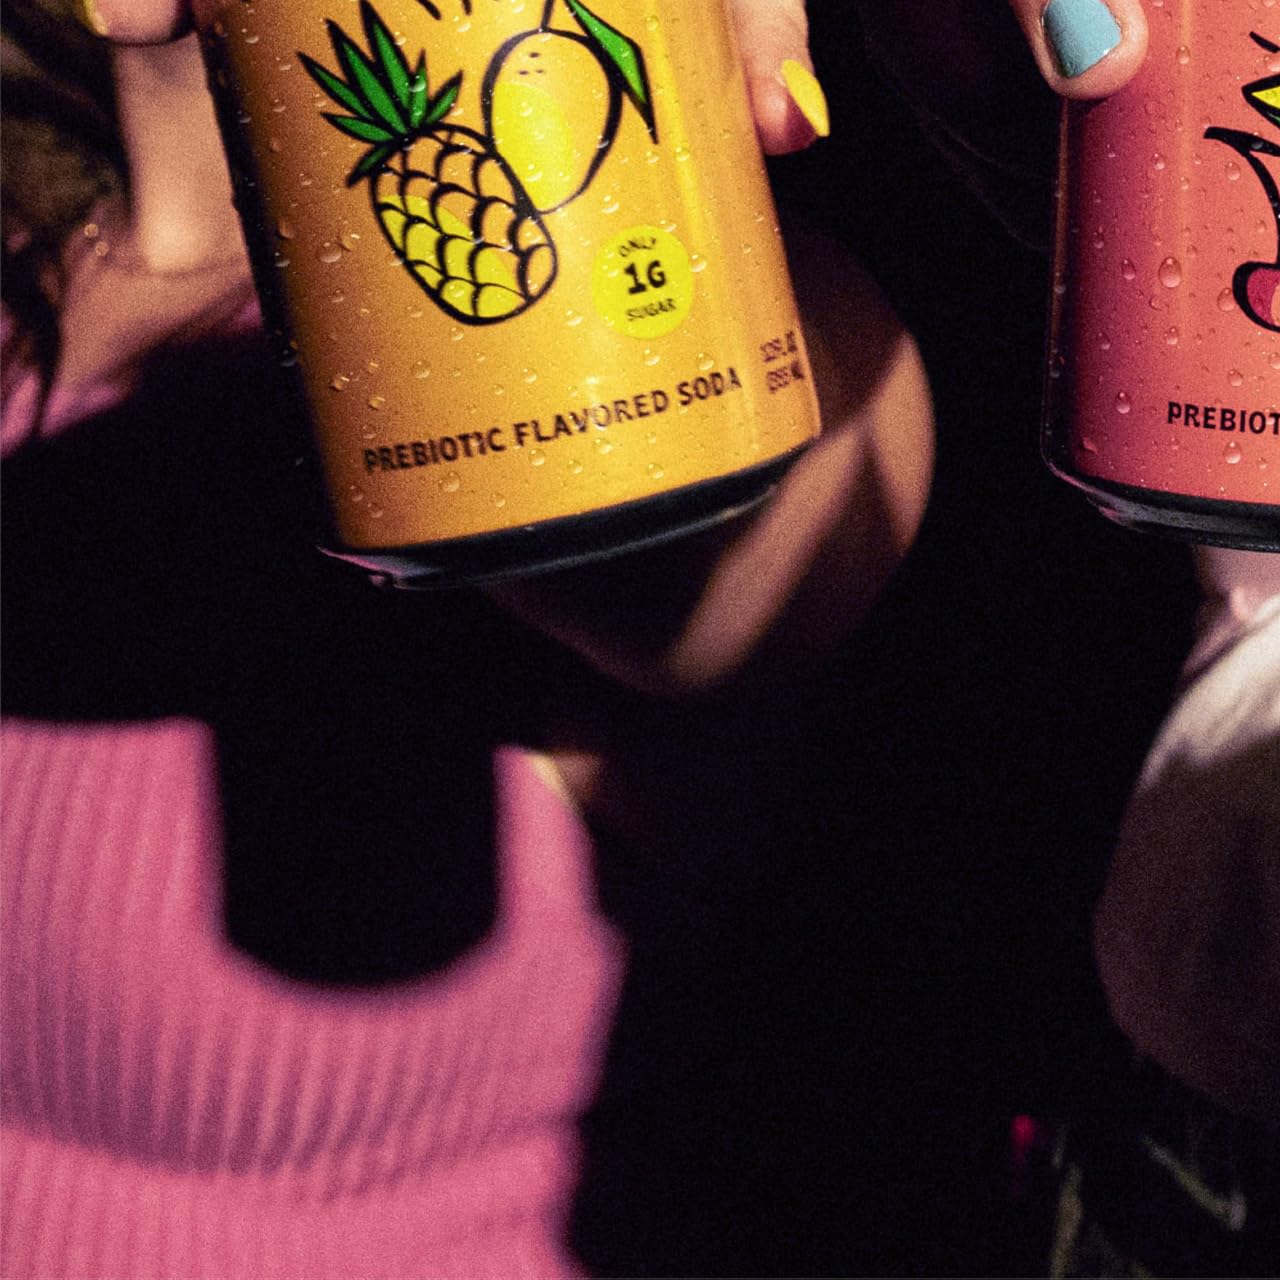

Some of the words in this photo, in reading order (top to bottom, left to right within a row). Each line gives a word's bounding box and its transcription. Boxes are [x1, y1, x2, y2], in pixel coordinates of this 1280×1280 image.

[619, 236, 657, 258] ONLY
[623, 259, 667, 295] 1G
[624, 298, 677, 322] SUGAR
[362, 427, 507, 474] PREBIOTIC
[514, 390, 671, 449] FLAVORED
[676, 367, 743, 407] SODA
